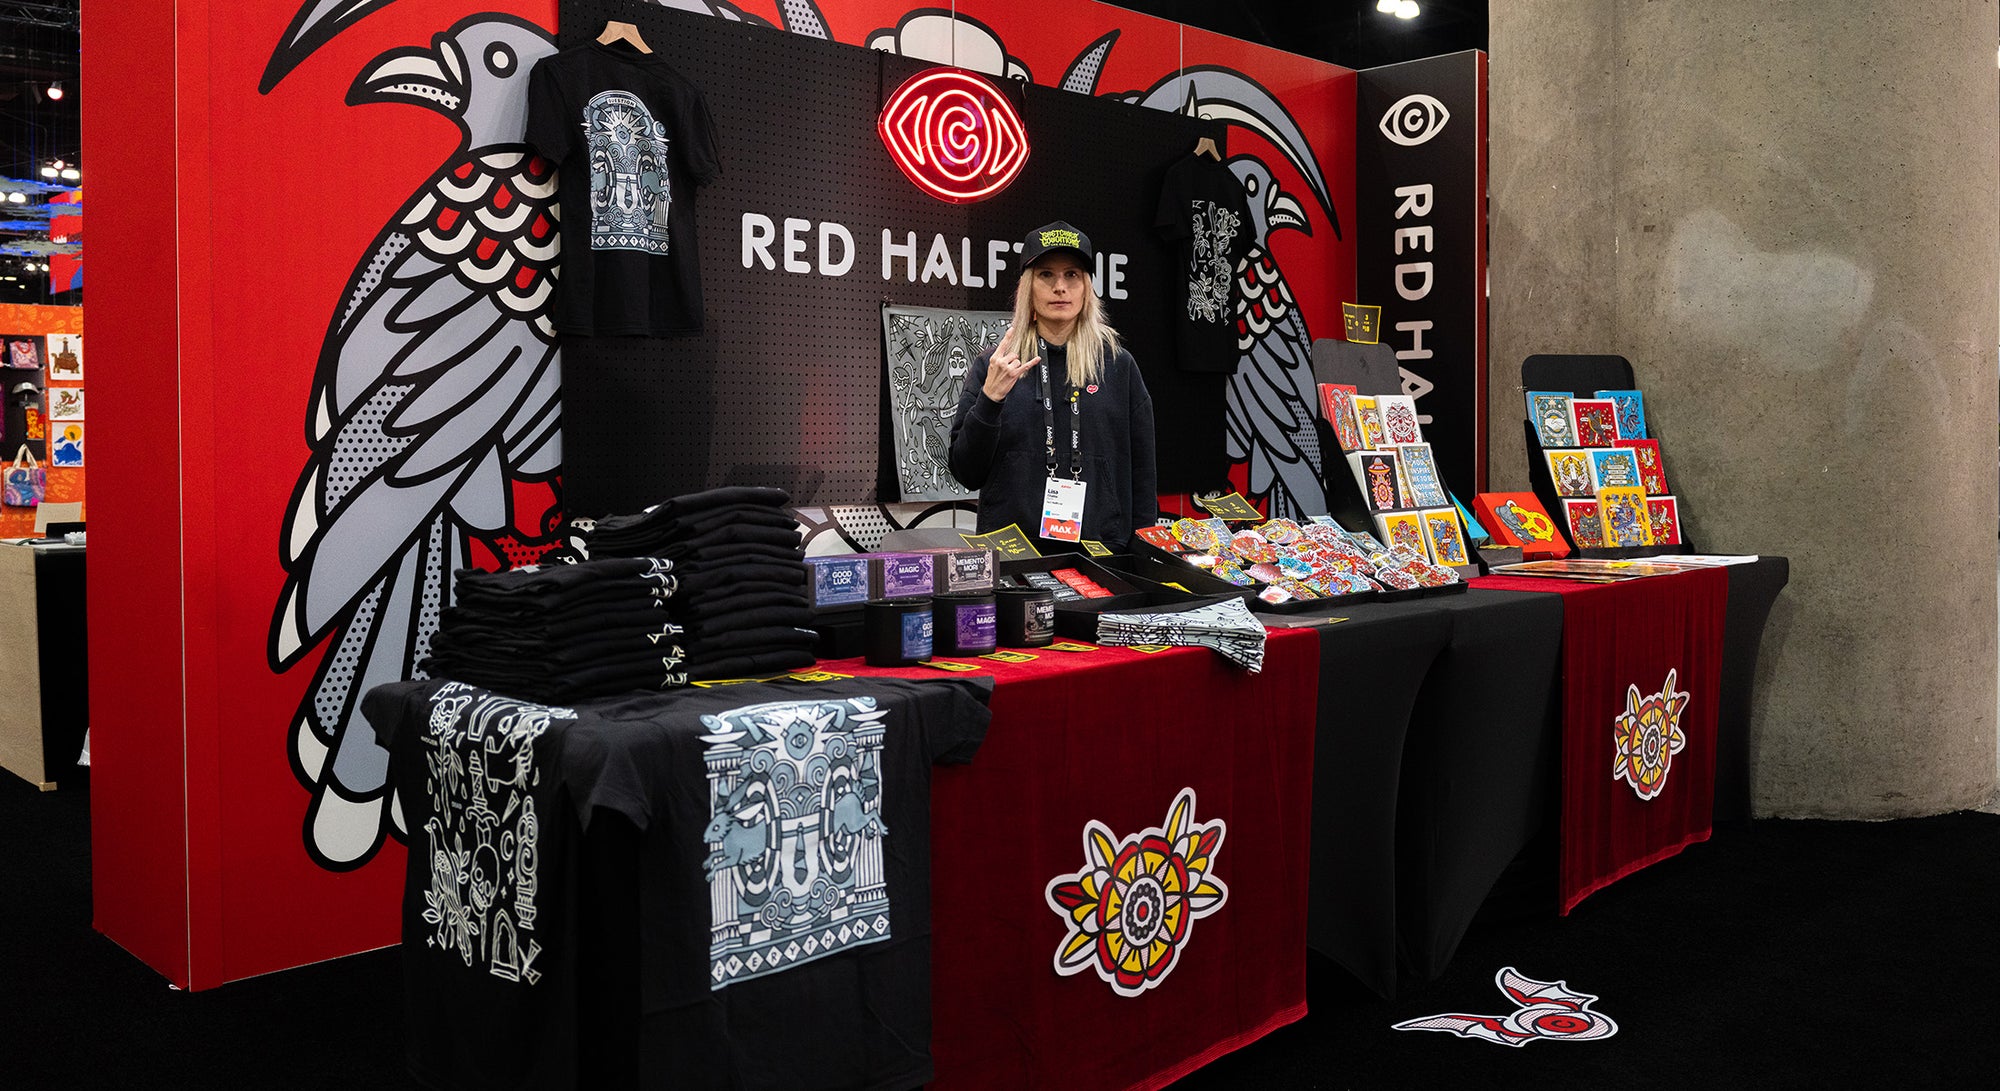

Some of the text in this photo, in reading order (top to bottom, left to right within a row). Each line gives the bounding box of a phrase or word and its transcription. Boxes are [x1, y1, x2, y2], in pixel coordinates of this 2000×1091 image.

[742, 212, 855, 276] RED
[1395, 183, 1434, 301] RED
[1049, 525, 1072, 534] MAX
[956, 557, 986, 566] MEMENTO
[898, 565, 920, 574] MAGIC
[963, 564, 979, 572] MORI
[832, 570, 853, 579] GOOD
[714, 919, 886, 977] EVERYTHING
